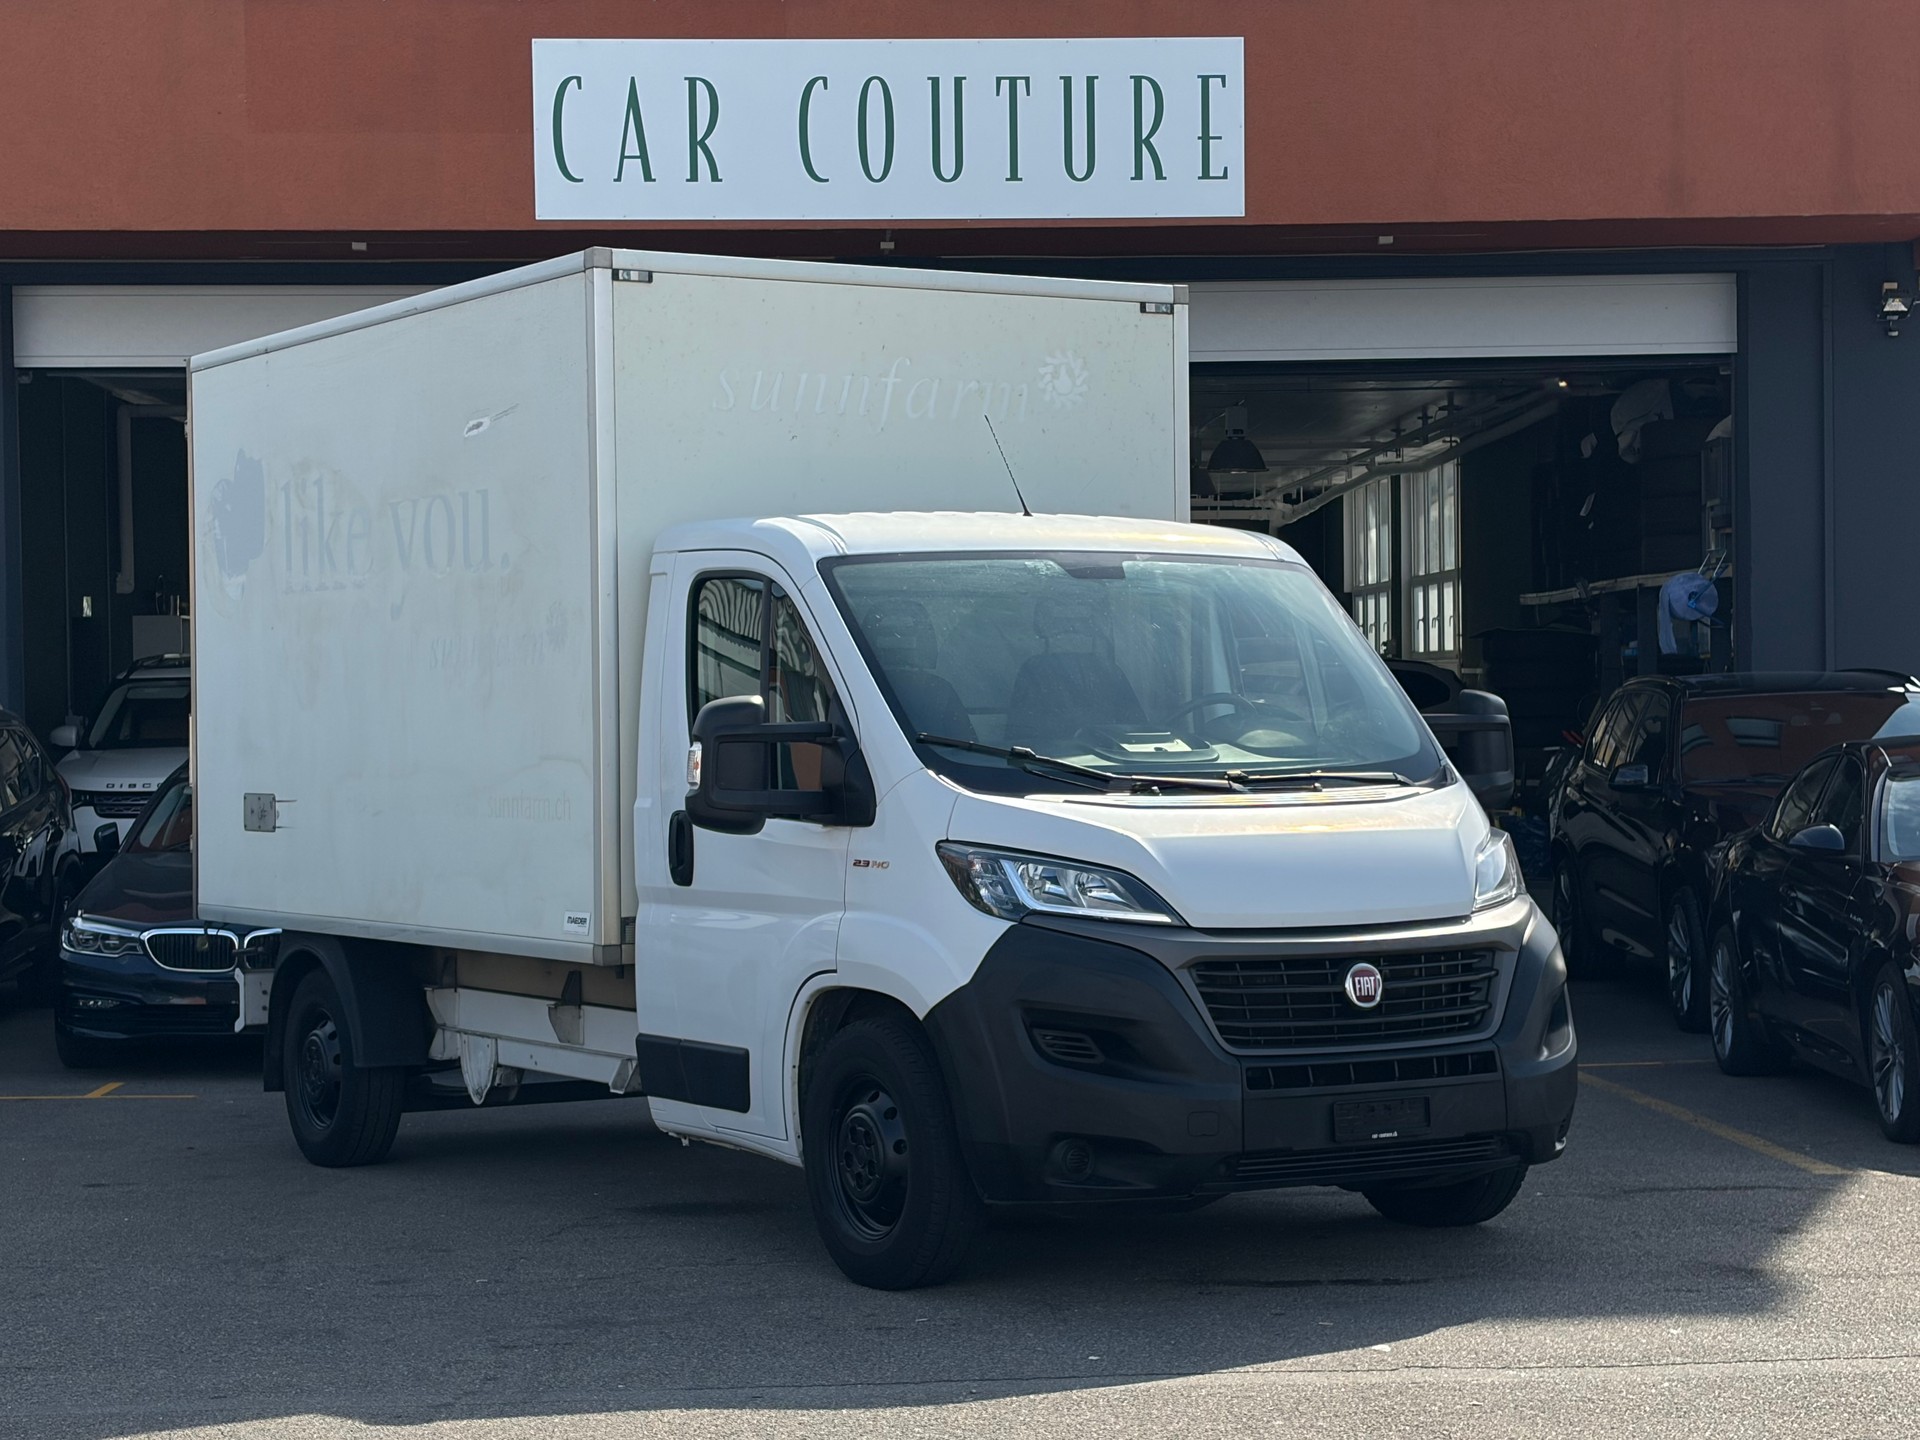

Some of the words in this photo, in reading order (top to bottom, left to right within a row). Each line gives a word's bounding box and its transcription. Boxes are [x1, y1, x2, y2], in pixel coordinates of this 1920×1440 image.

[552, 75, 723, 183] CAR
[798, 74, 1229, 183] COUTURE
[711, 355, 1030, 433] sunnfarm
[1354, 975, 1376, 998] FIAT
